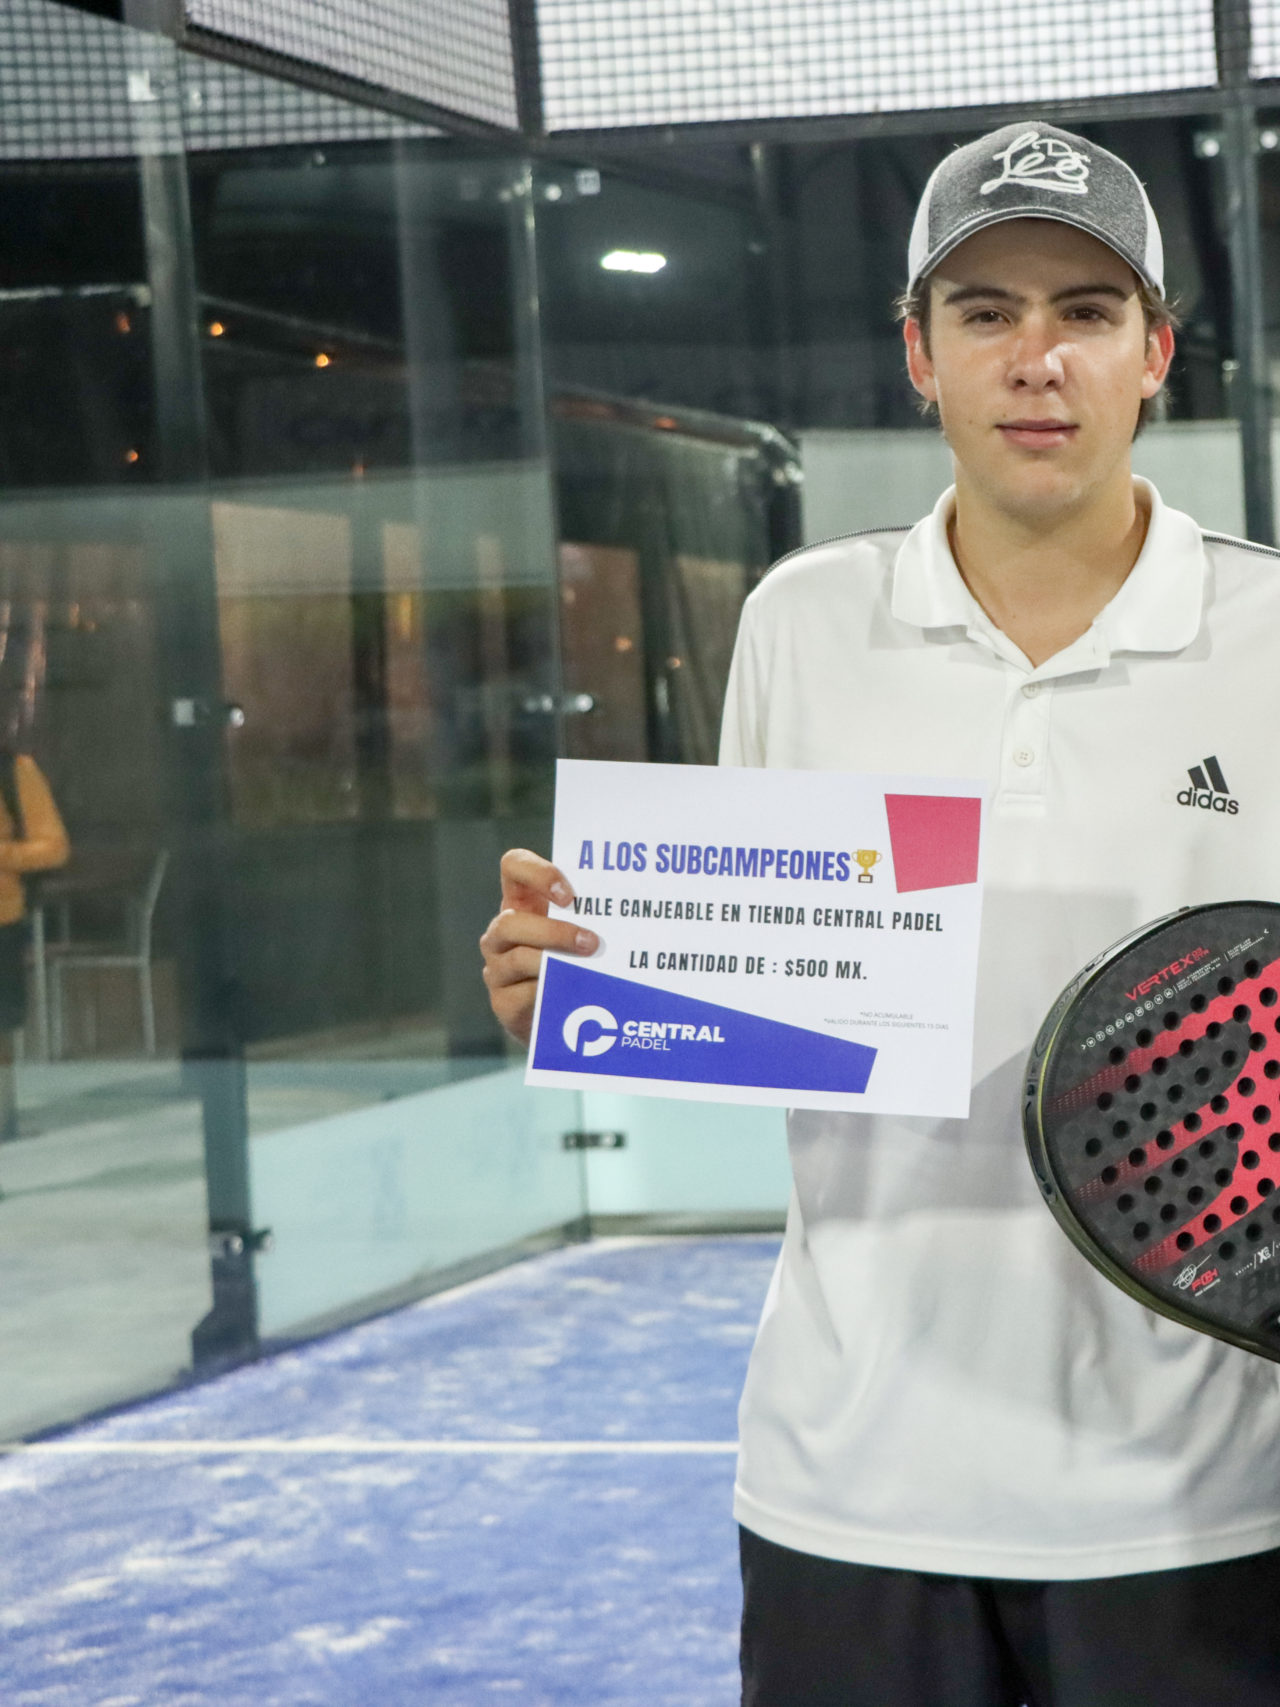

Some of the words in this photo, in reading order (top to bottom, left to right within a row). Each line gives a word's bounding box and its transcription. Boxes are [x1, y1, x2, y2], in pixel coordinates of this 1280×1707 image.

[1176, 787, 1240, 815] adidas
[578, 839, 594, 870] A
[602, 841, 648, 873] LOS
[655, 843, 851, 882] SUBCAMPEONES
[573, 895, 613, 916] VALE
[620, 898, 714, 921] CANJEABLE
[721, 903, 741, 922] EN
[748, 904, 805, 926] TIENDA
[813, 907, 884, 929] CENTRAL
[892, 911, 943, 932] PADEL
[629, 950, 649, 969] LA
[656, 951, 738, 974] CANTIDAD
[745, 956, 765, 975] DE
[784, 958, 828, 978] $500
[835, 960, 867, 980] MX.
[1125, 952, 1195, 1001] VERTEX
[621, 1036, 671, 1051] PADEL
[622, 1020, 725, 1043] CENTRAL
